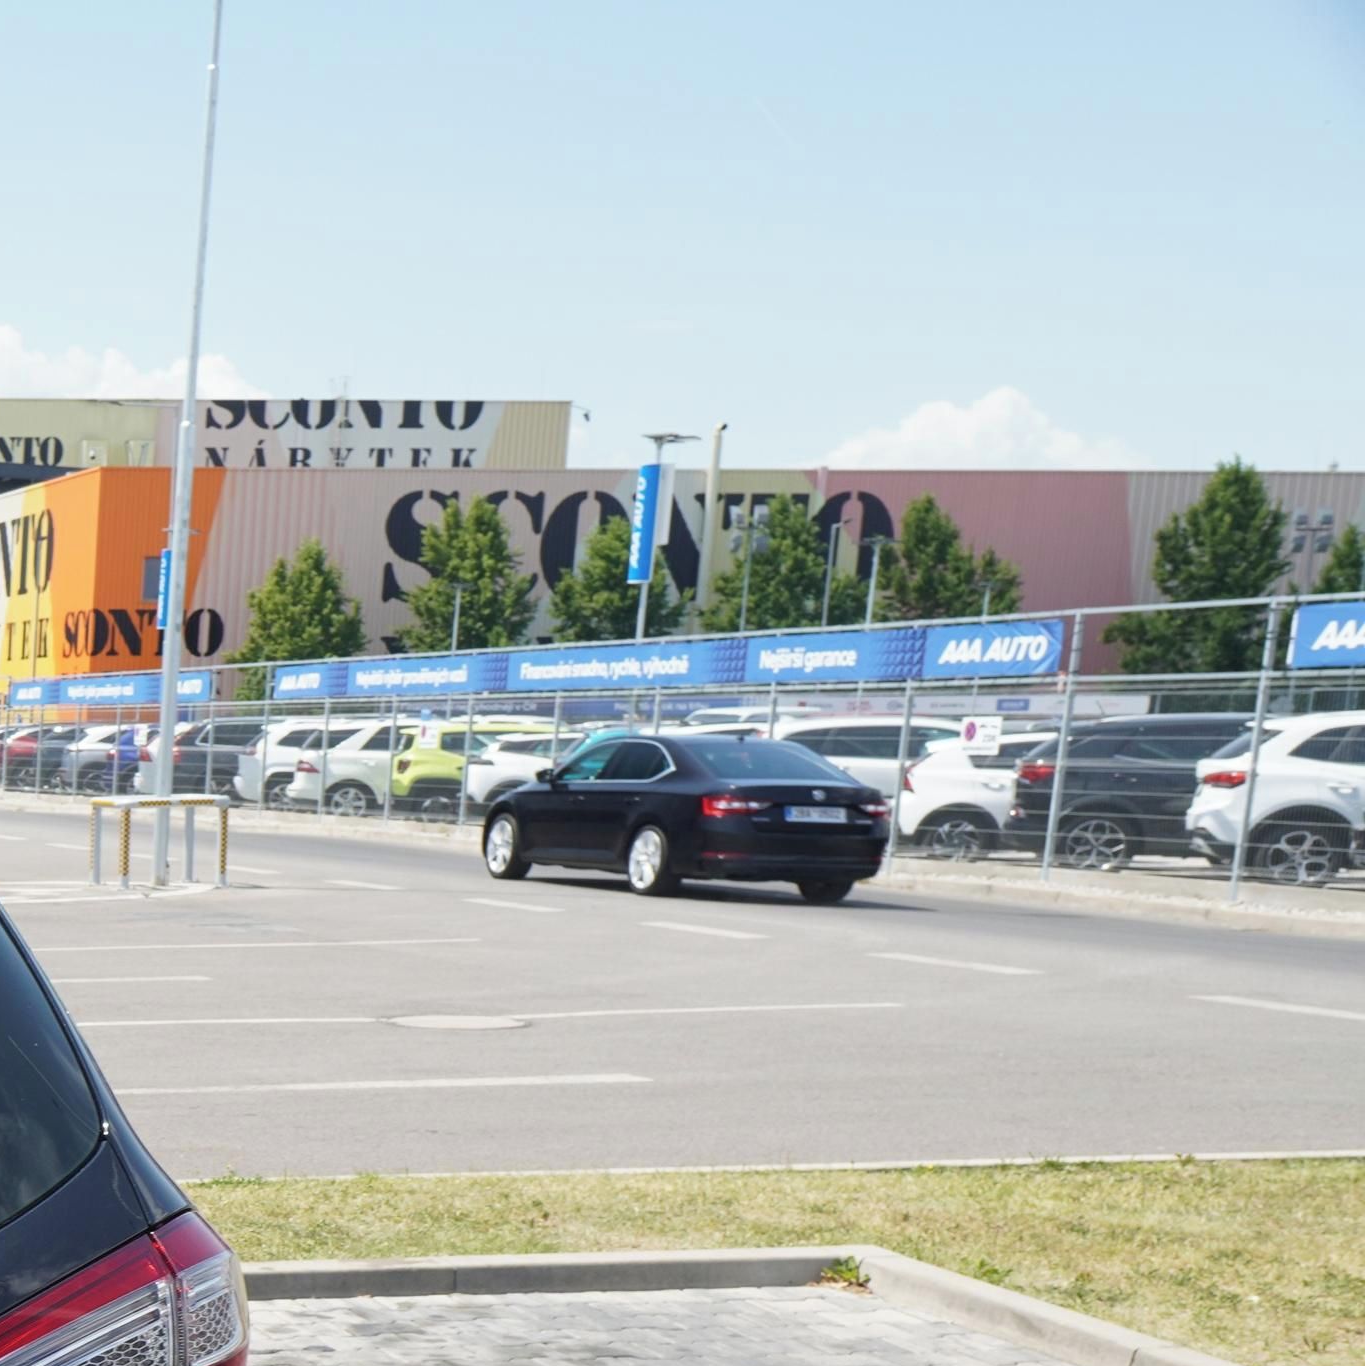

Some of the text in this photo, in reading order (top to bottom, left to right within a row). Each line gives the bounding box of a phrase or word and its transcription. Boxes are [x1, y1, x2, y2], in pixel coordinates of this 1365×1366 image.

[205, 399, 484, 430] SCONTO
[938, 635, 1048, 664] AAA AUTO
